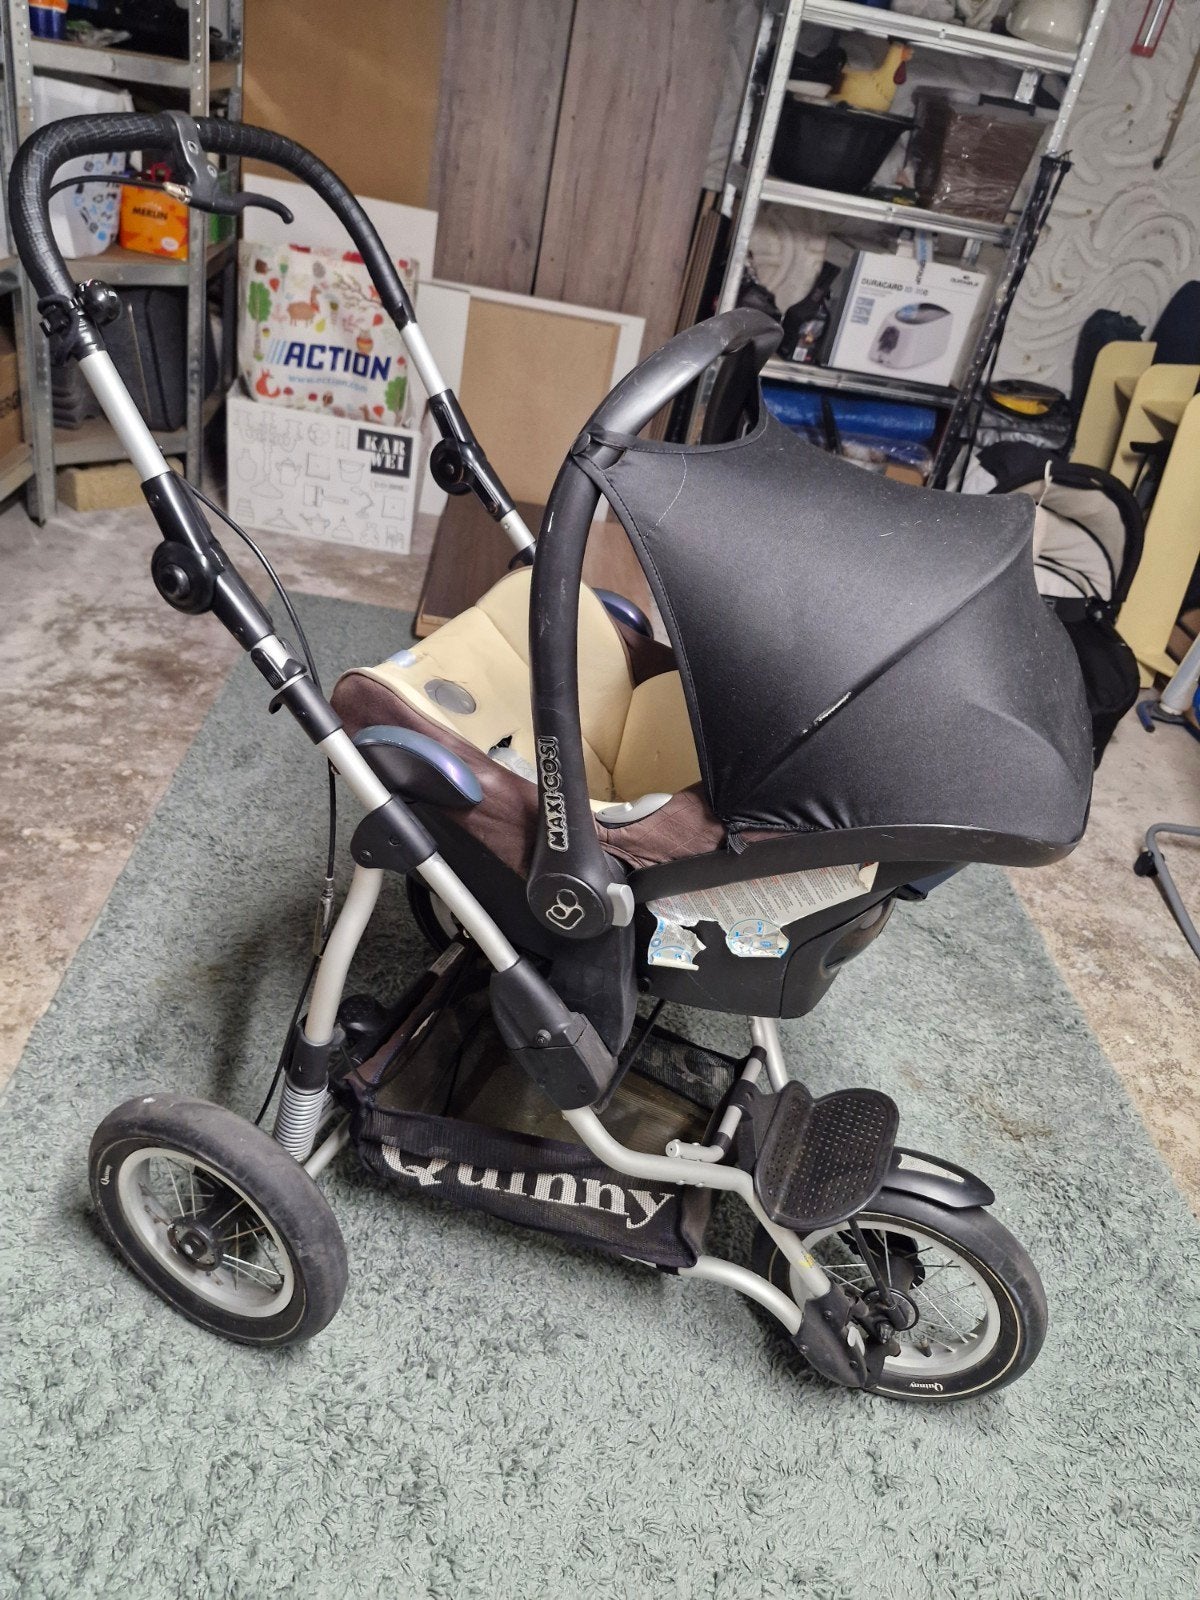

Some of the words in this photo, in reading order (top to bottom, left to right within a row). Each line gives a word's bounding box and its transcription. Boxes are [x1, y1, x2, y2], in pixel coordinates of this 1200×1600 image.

[284, 342, 391, 381] ACTION
[364, 434, 406, 455] KAR
[371, 452, 405, 470] WEI
[909, 1381, 943, 1391] Quinny
